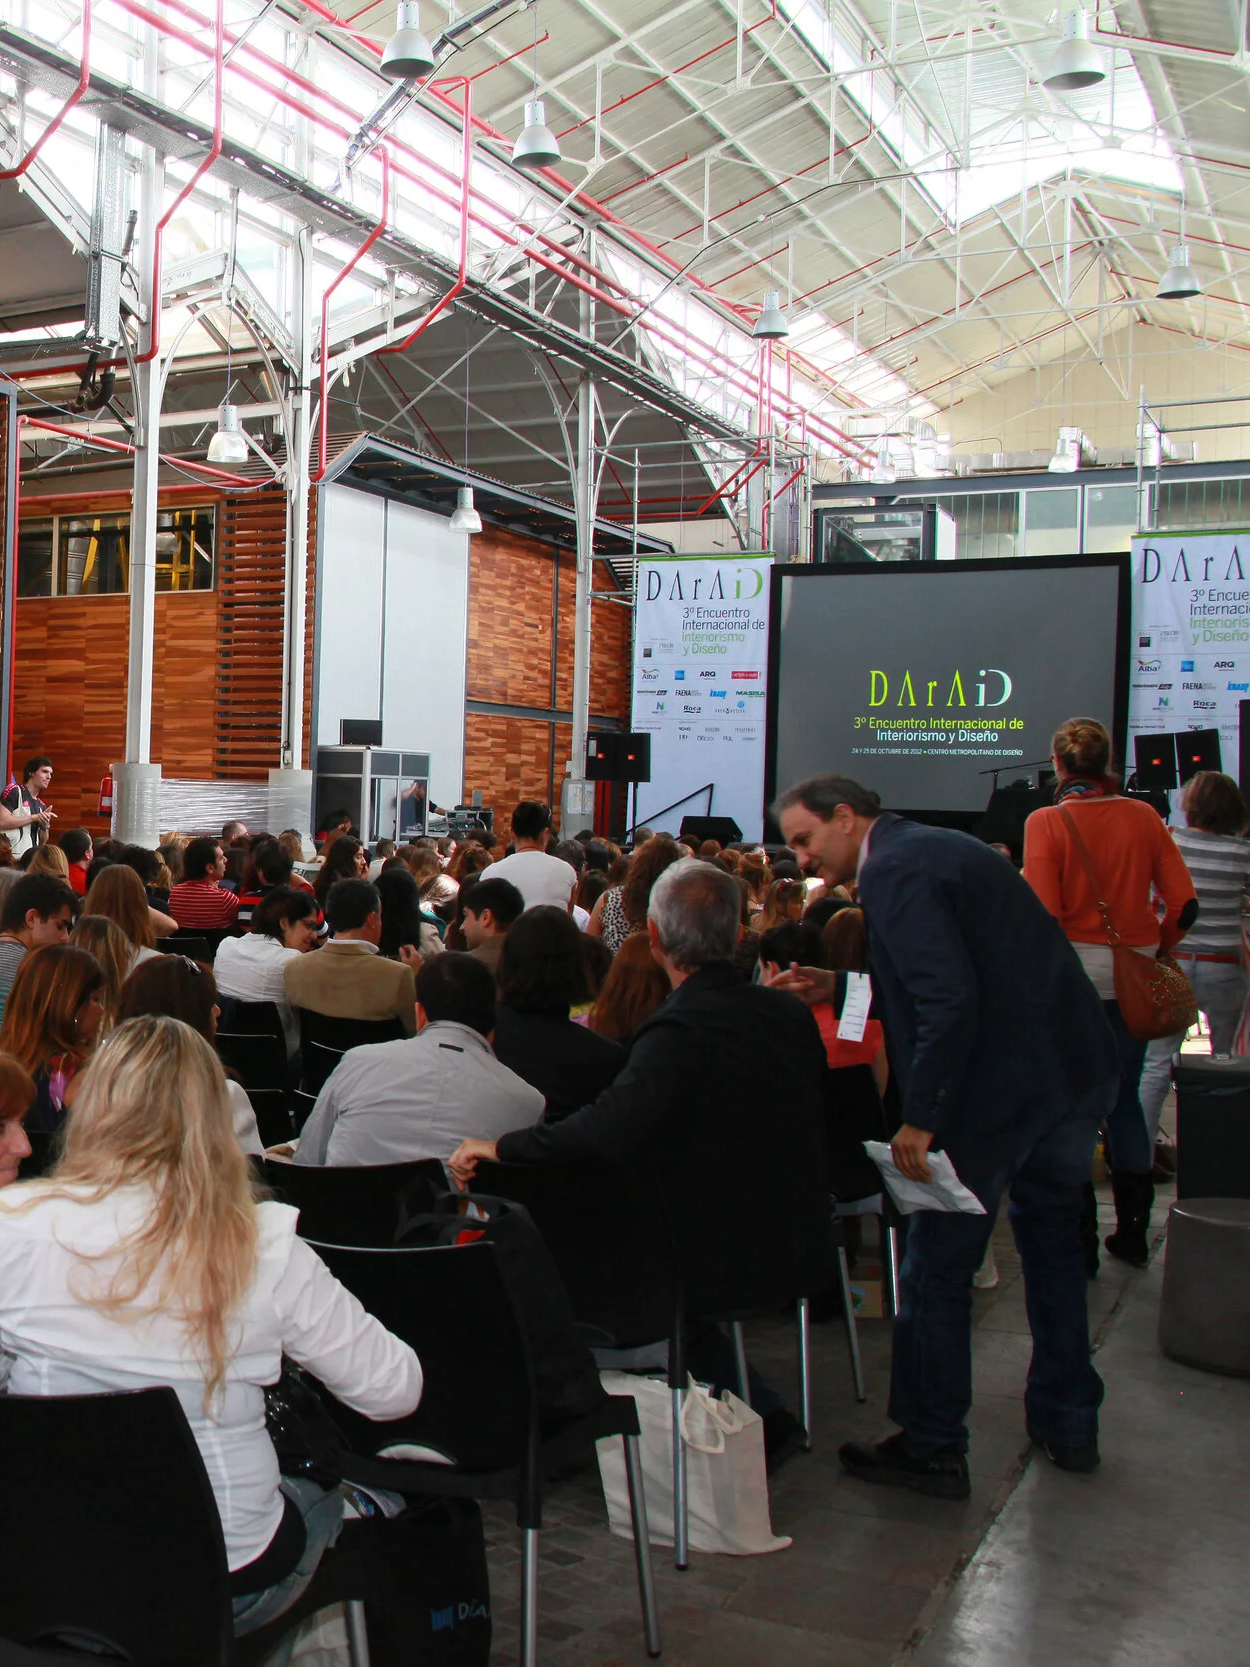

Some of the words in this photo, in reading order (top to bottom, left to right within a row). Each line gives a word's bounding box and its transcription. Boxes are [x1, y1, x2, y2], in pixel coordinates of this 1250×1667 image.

[1208, 589, 1250, 601] Encue
[697, 607, 750, 618] Encuentro
[1191, 602, 1250, 615] Internaci
[682, 619, 750, 630] Internacional
[752, 619, 765, 630] de
[1190, 616, 1250, 628] Interioris
[682, 632, 744, 642] Interiorismo
[1192, 633, 1199, 645] y
[1203, 630, 1248, 642] Diseño
[683, 646, 690, 656] y
[692, 643, 726, 654] Diseño
[869, 718, 926, 729] Encuentro
[930, 718, 1006, 729] Internacional
[1009, 718, 1024, 729] de
[877, 730, 946, 741] Interiorismo
[948, 732, 956, 744] y
[958, 730, 998, 742] Diseño
